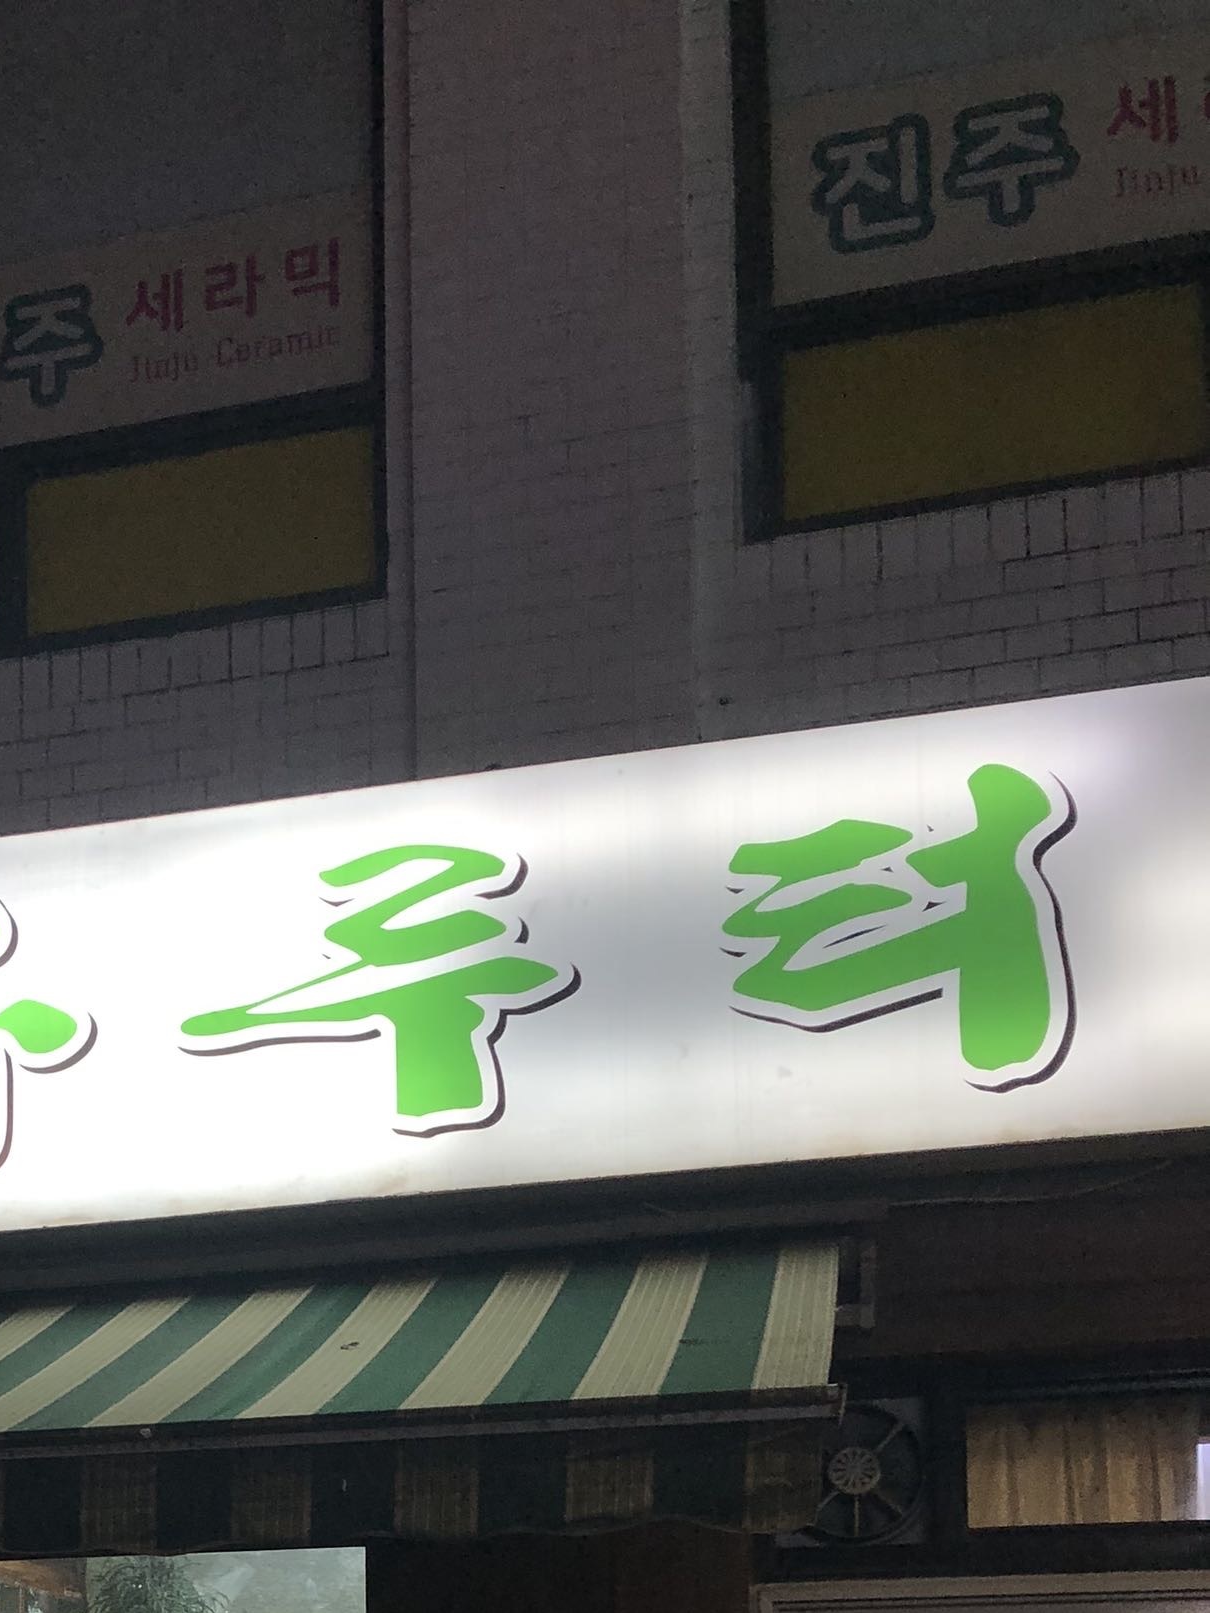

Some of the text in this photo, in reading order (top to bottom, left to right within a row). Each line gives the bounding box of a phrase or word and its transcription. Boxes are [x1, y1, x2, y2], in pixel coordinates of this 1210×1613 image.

[811, 93, 1081, 254] 진주
[126, 237, 342, 332] 세라믹
[215, 325, 342, 368] Ceramic
